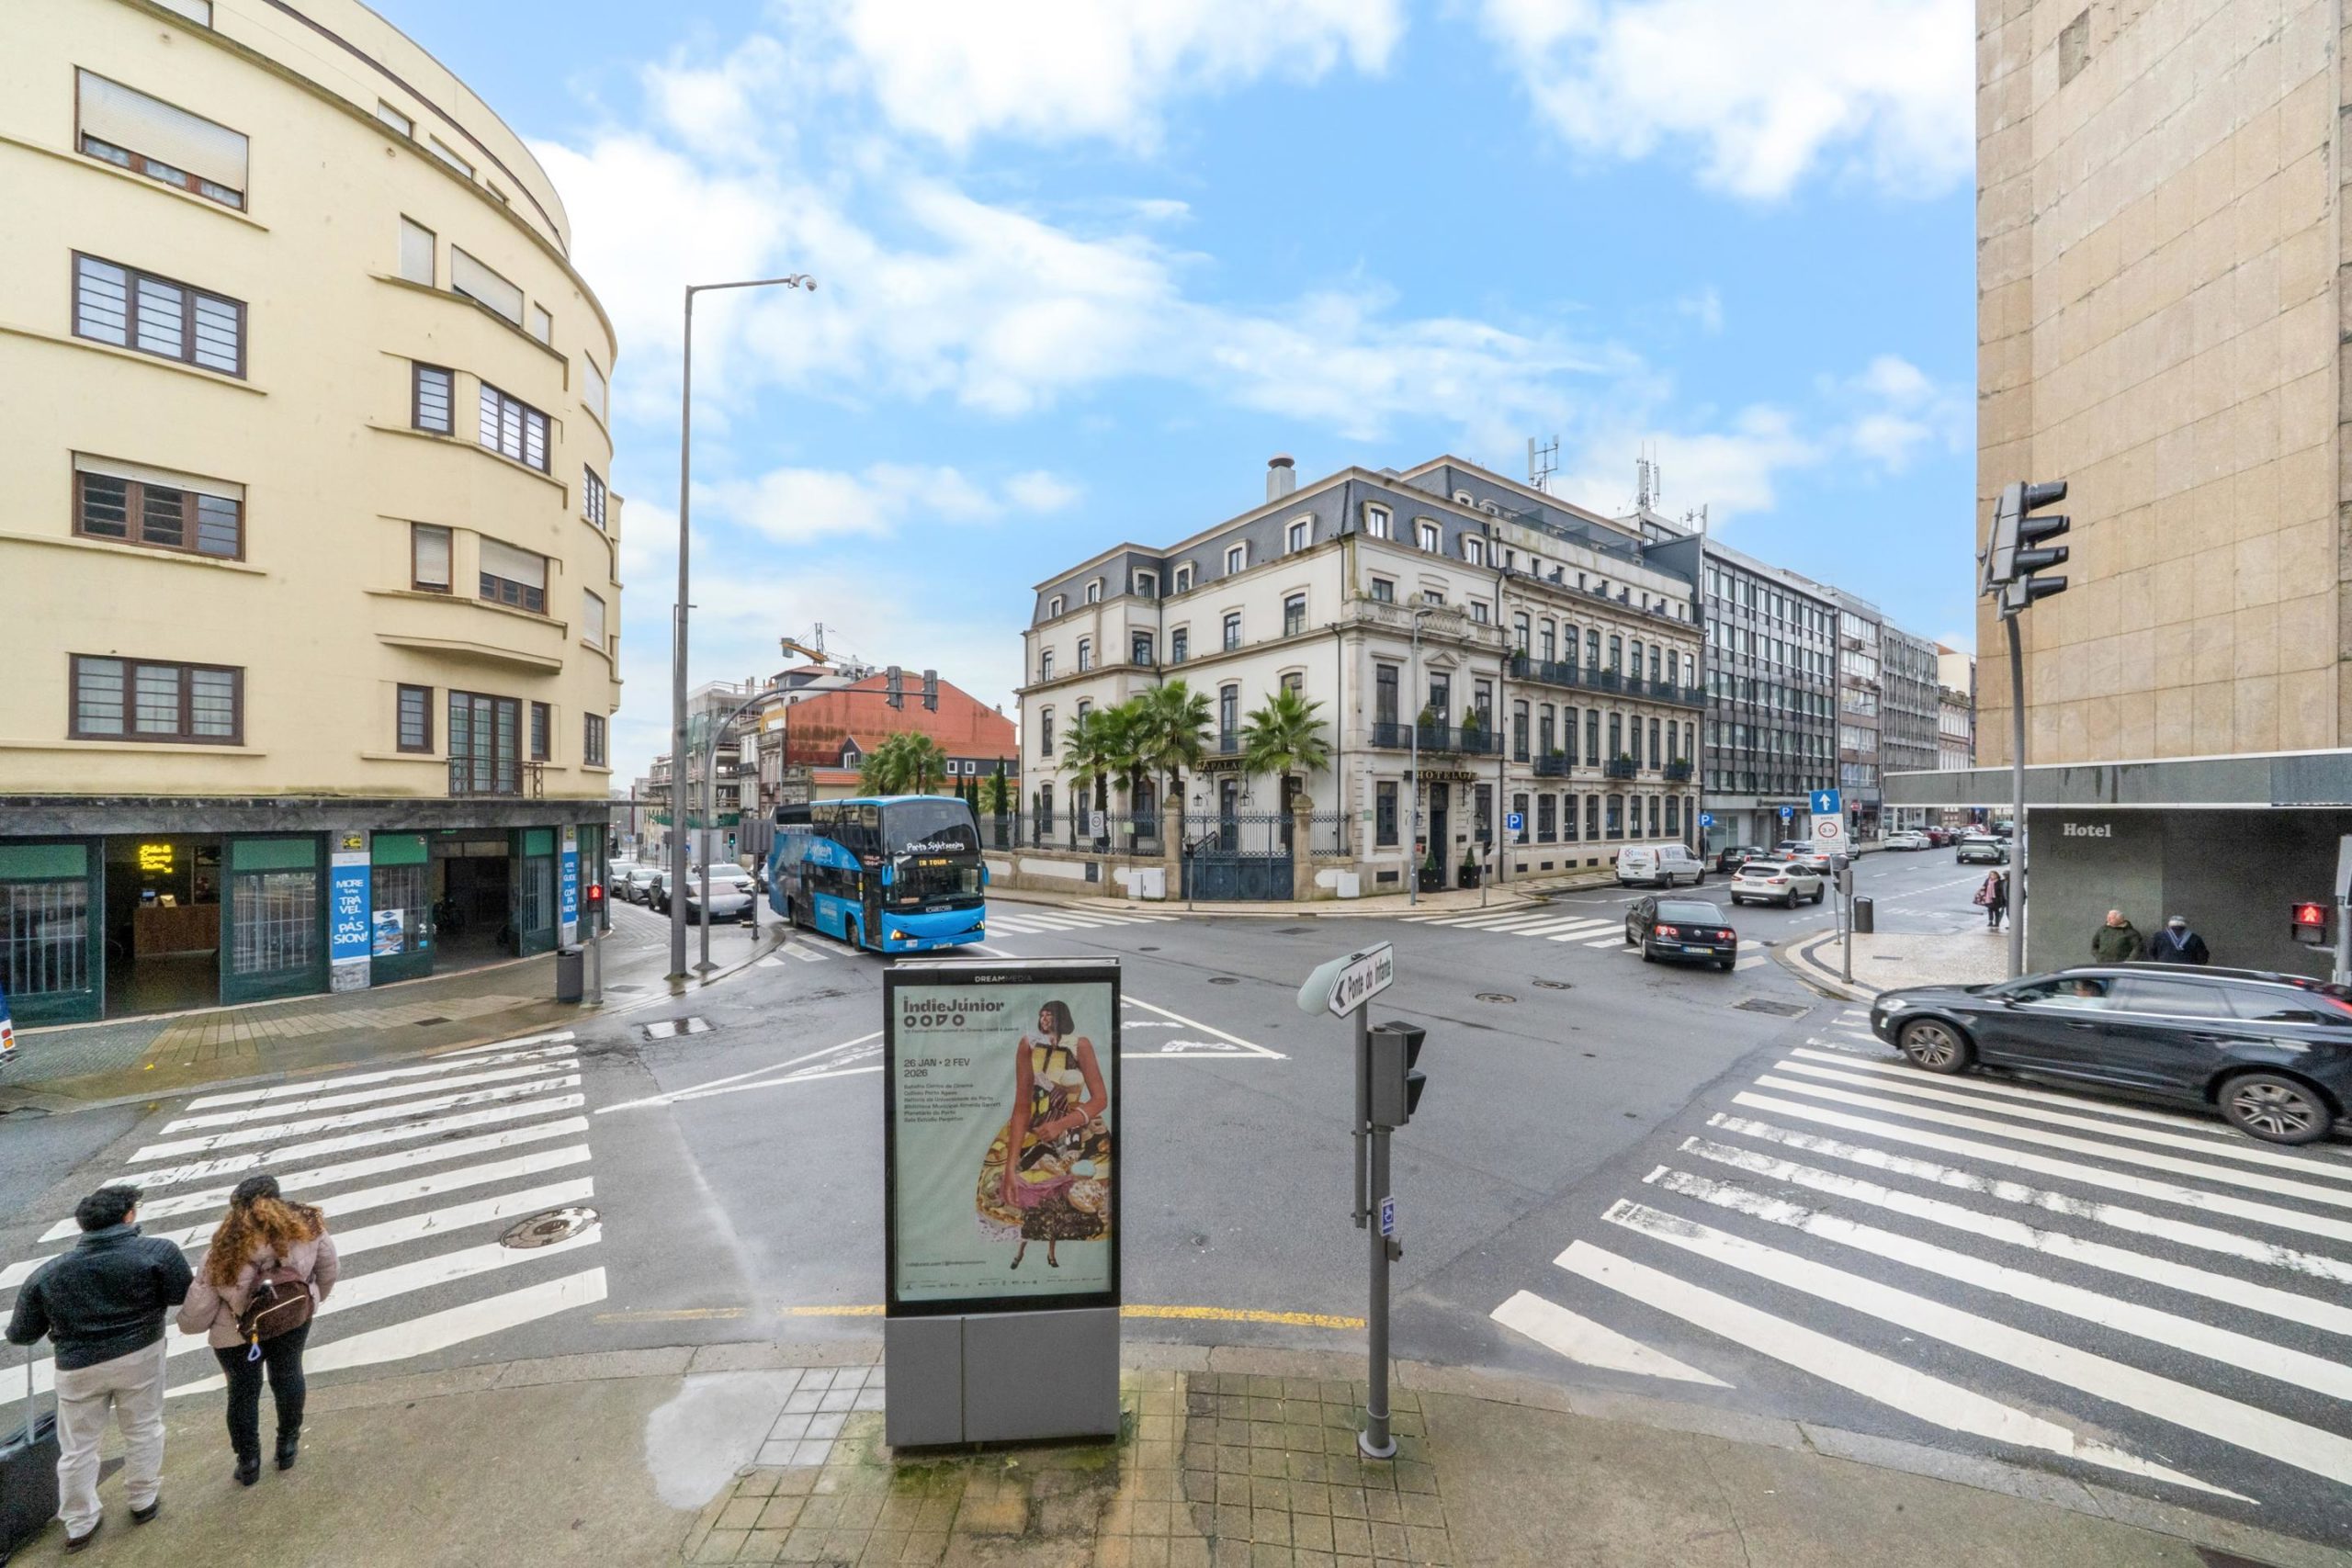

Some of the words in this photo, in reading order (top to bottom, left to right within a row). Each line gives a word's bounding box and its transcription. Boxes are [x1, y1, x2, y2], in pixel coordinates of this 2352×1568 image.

[1510, 815, 1520, 828] P
[1702, 815, 1710, 825] P
[2063, 823, 2111, 838] Hotel
[907, 842, 927, 852] Porto
[928, 841, 965, 852] Sightseeing
[336, 879, 364, 888] MORE
[339, 896, 362, 906] TRA
[339, 906, 362, 915] VEL
[338, 921, 365, 933] PAS
[334, 931, 368, 945] SION!
[1348, 972, 1363, 1003] Ponte
[1366, 964, 1374, 990] do
[1375, 956, 1391, 985] Infante
[919, 1058, 937, 1066] JAN
[944, 1058, 951, 1066] 2
[903, 1069, 928, 1077] 2026
